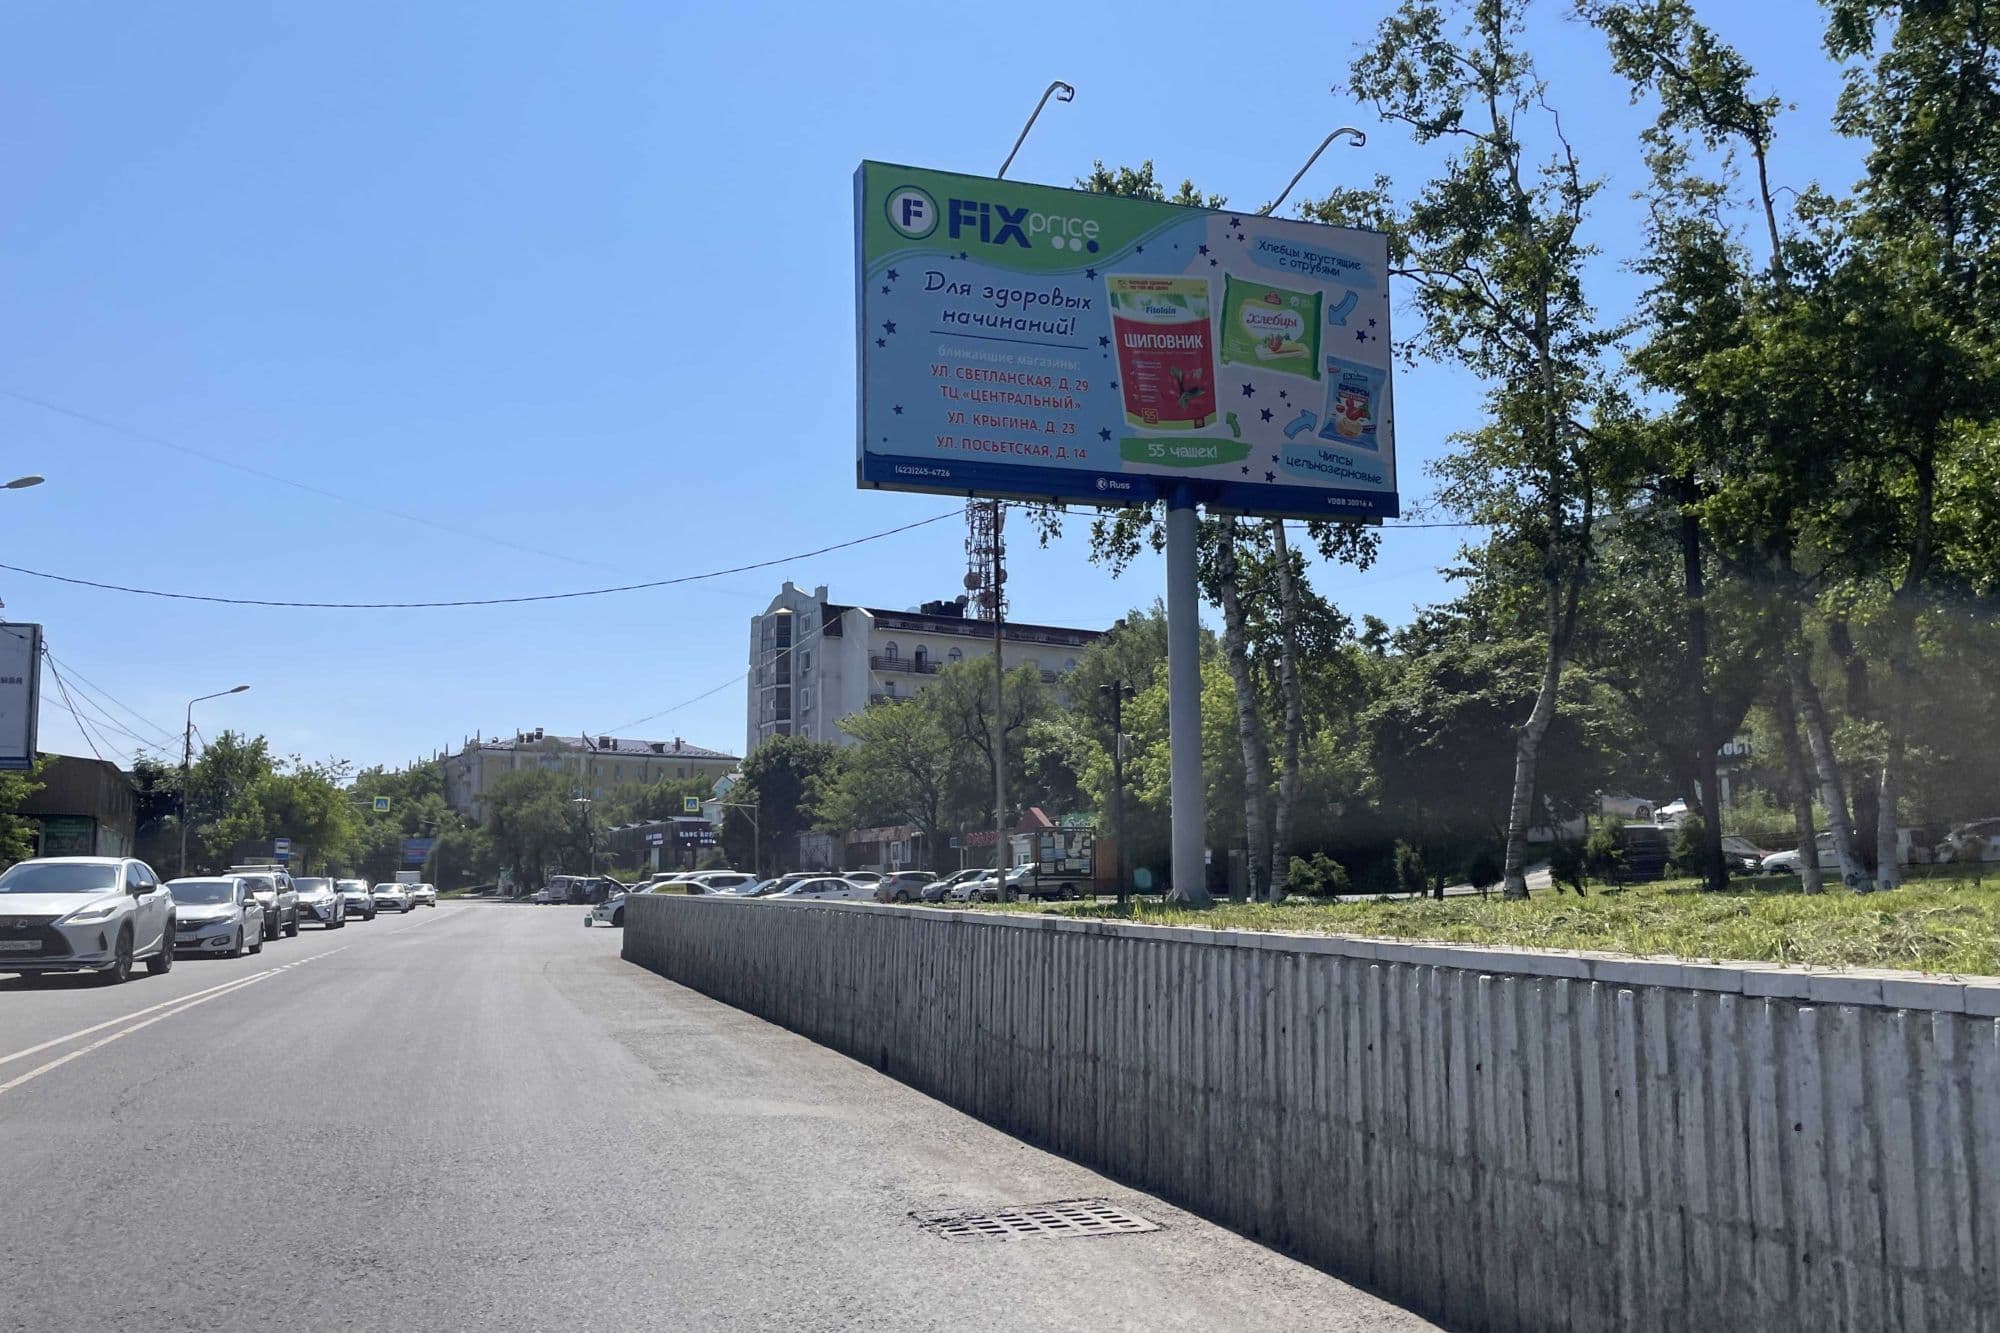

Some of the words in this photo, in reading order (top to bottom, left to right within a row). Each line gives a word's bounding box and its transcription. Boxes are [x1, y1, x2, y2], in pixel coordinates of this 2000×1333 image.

[1290, 260, 1341, 277] отрубями
[1303, 251, 1362, 271] хрустящие
[925, 271, 971, 296] Для
[982, 286, 1093, 312] здоровых
[942, 310, 1076, 336] начинаний!
[1124, 333, 1204, 349] ШИПОВНИК
[938, 344, 1014, 364] ближайшие
[1017, 354, 1081, 371] магазины:
[931, 364, 951, 378] УЛ.
[956, 367, 1056, 389] СВЕТЛАНСКАЯ,
[1058, 378, 1073, 391] Д.
[1075, 380, 1089, 392] 29
[940, 385, 959, 399] ТЦ
[963, 389, 1081, 410] «ЦЕНТРАЛЬНЫЙ»
[948, 412, 967, 425] УЛ.
[973, 414, 1041, 432] КРЫГИНА,
[1045, 422, 1058, 434] Д.
[1062, 423, 1075, 434] 23
[936, 436, 958, 449] УЛ.
[1056, 447, 1070, 459] Д.
[1074, 449, 1087, 458] 14
[1148, 444, 1165, 457] 55
[1170, 446, 1218, 458] чашек!
[895, 465, 951, 477] (423)245-4726
[1286, 456, 1383, 485] цельнозерновые
[1109, 480, 1131, 490] Russ
